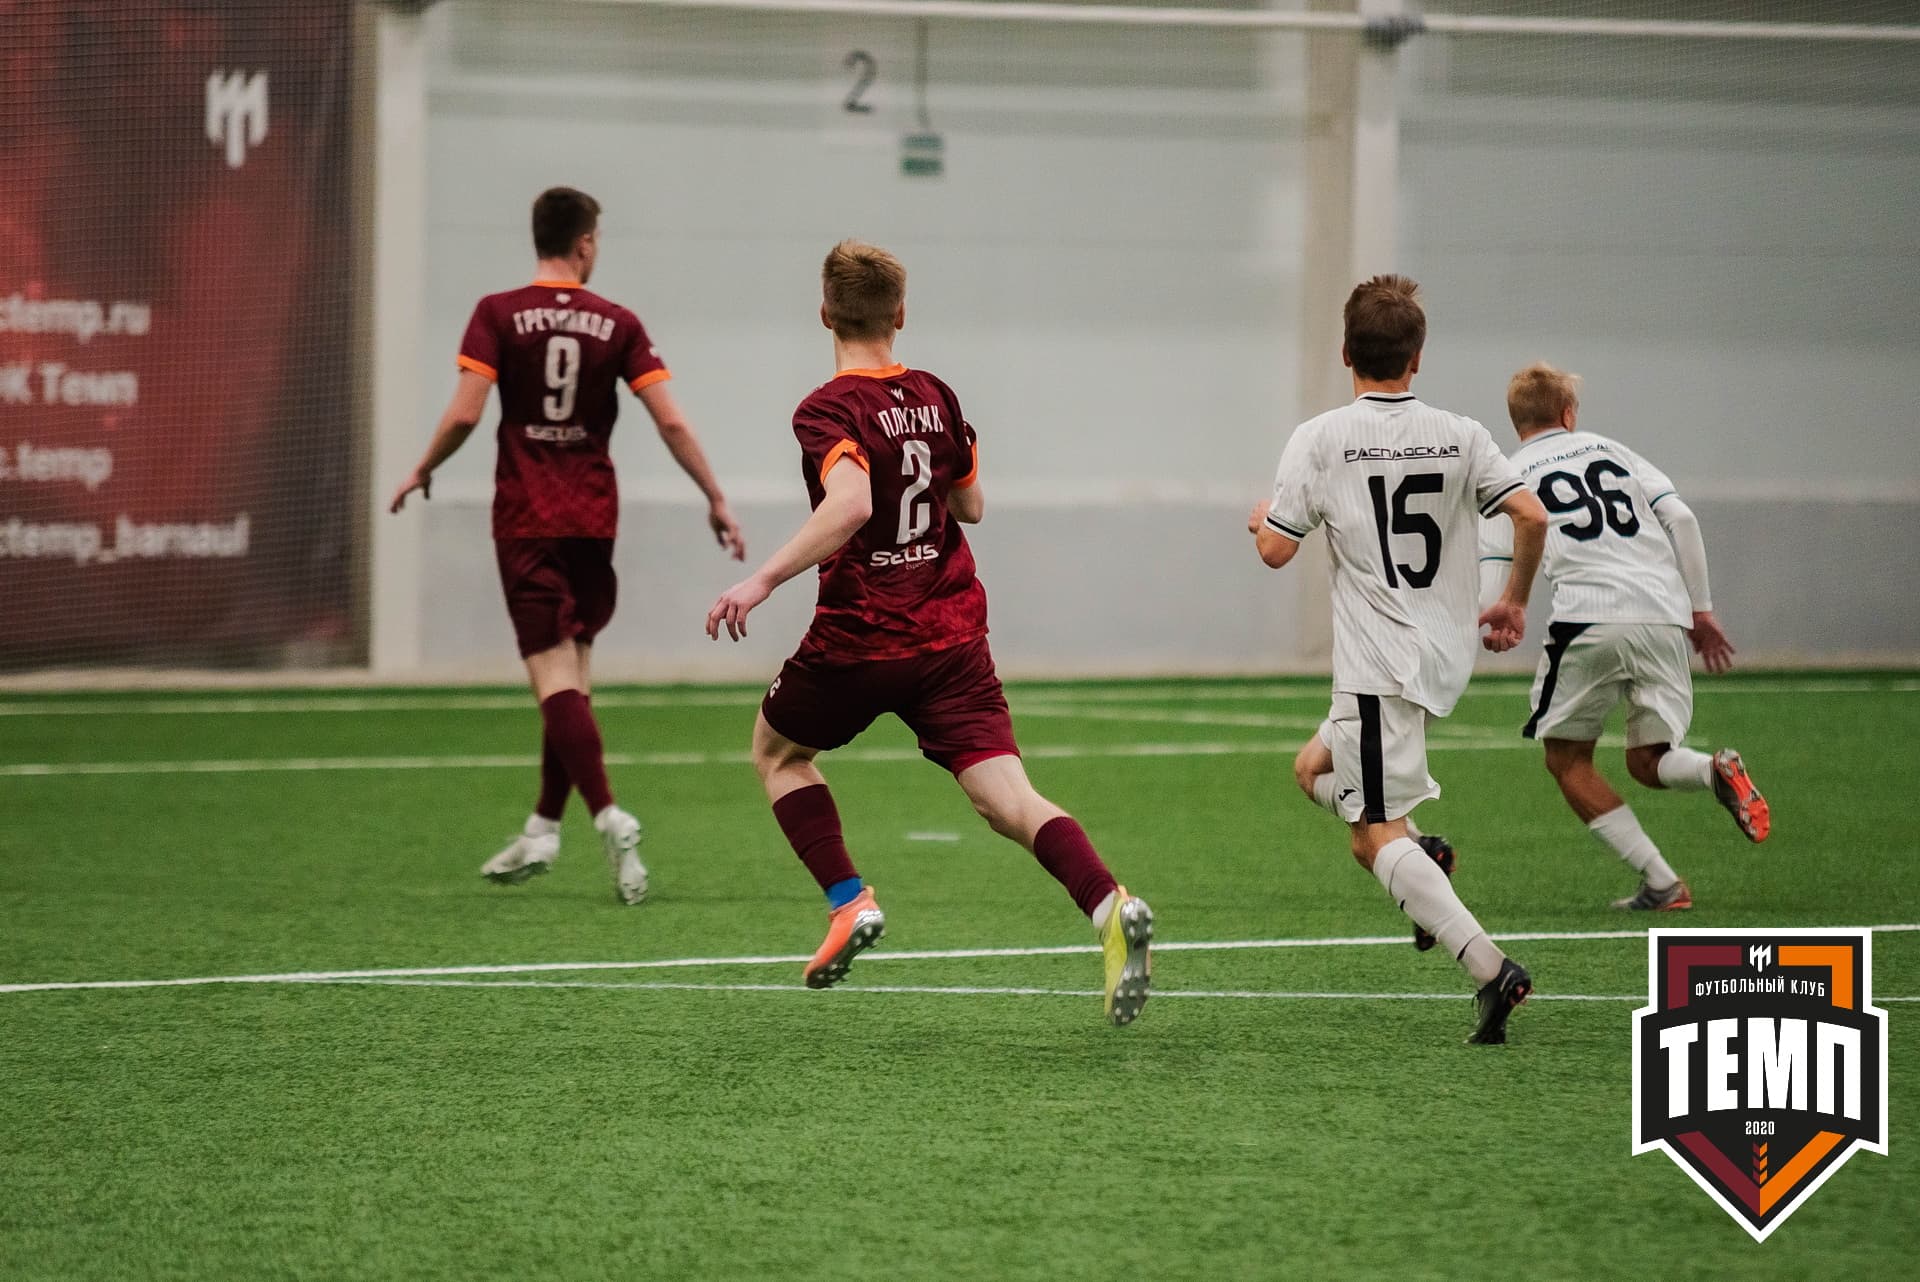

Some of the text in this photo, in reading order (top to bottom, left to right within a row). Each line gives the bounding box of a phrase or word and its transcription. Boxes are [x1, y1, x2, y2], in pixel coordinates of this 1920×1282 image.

[844, 51, 877, 114] 2
[543, 335, 581, 421] 9
[896, 440, 932, 544] 2
[1368, 473, 1445, 589] 15
[1537, 459, 1641, 542] 96
